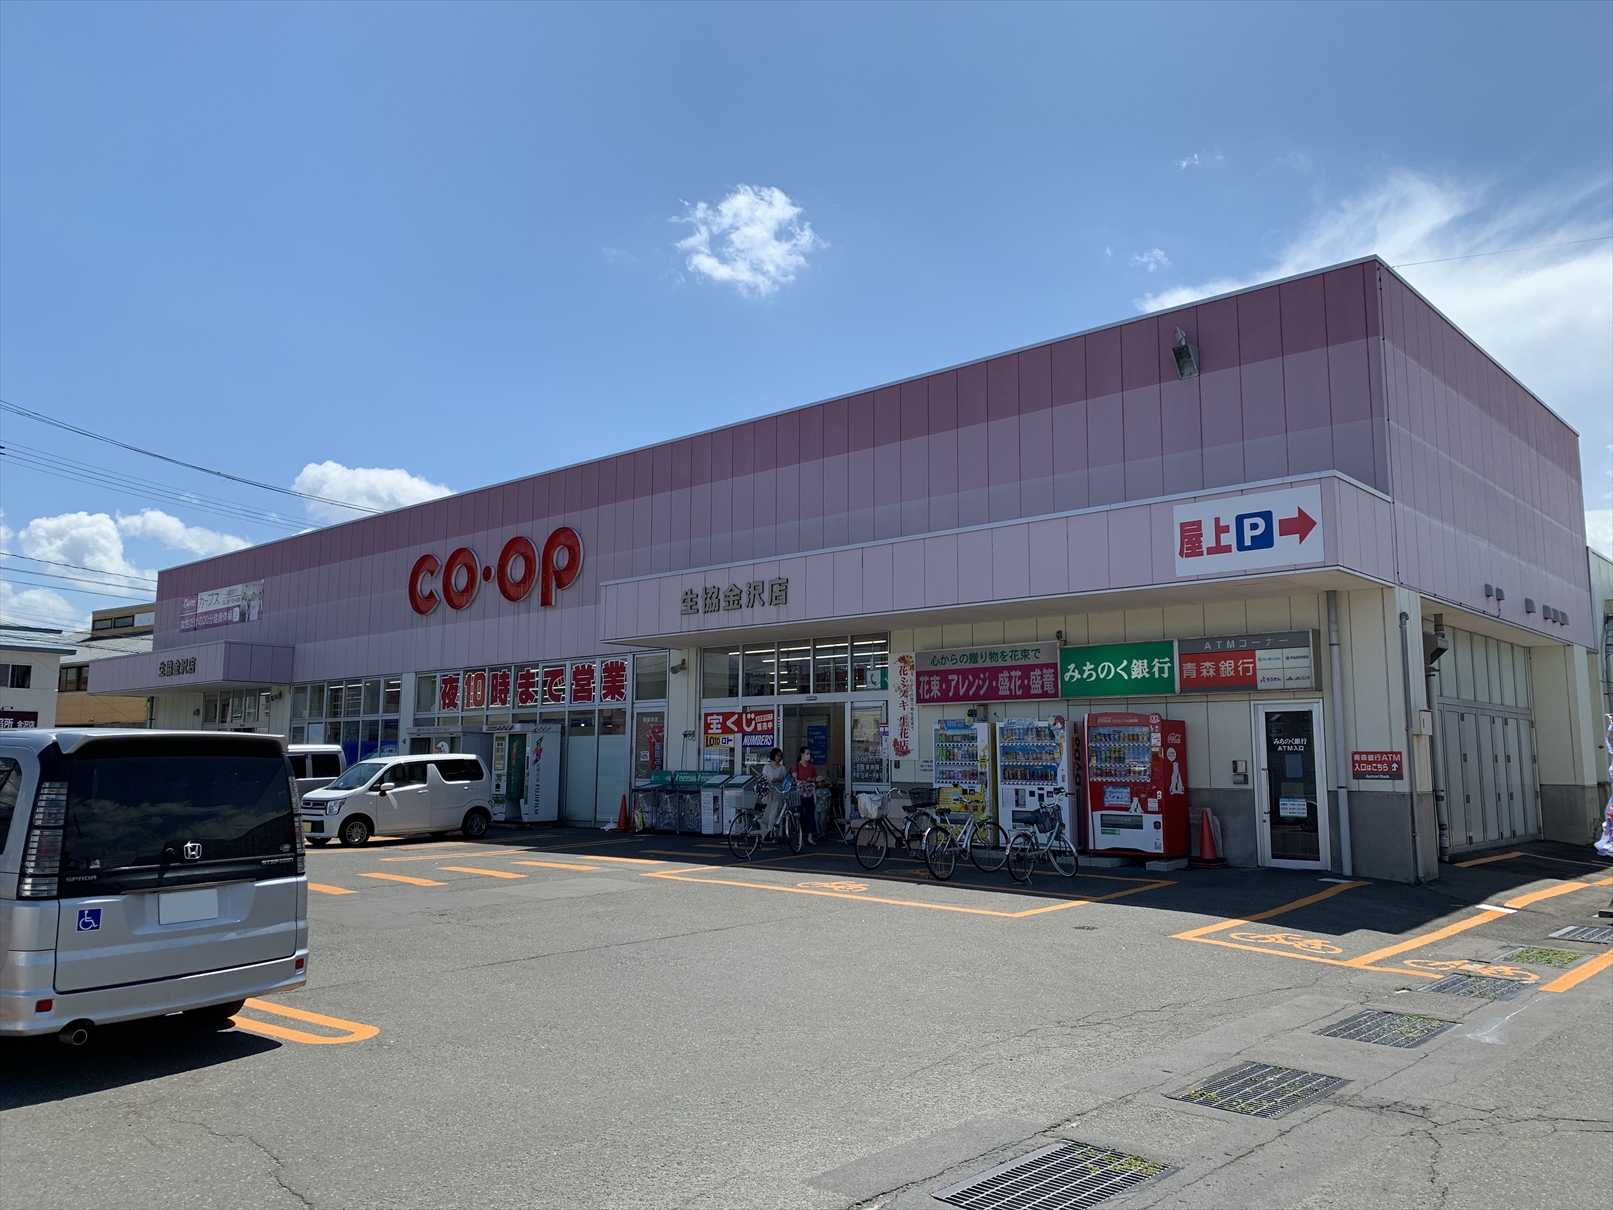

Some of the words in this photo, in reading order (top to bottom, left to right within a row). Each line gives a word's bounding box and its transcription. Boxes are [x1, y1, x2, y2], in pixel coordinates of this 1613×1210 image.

[1178, 516, 1232, 559] 屋上
[198, 592, 220, 609] カーブス
[680, 576, 789, 615] 生協金沢店
[1204, 637, 1289, 650] ATMコーナー
[930, 648, 1042, 667] 心からの贈り物を花束で
[158, 656, 197, 678] 生協金沢店
[1063, 656, 1173, 683] みちのく銀行
[1181, 658, 1255, 679] 青森銀行
[440, 659, 628, 711] 夜10時まで営業
[707, 713, 756, 734] 宝くじ
[705, 735, 721, 748] LOTO
[742, 734, 774, 747] NUMBERS
[1273, 737, 1308, 745] みちのく銀行
[1353, 753, 1401, 762] 青森銀行ATM
[1354, 763, 1389, 772] 入口はこちら
[65, 874, 98, 883] SPADA
